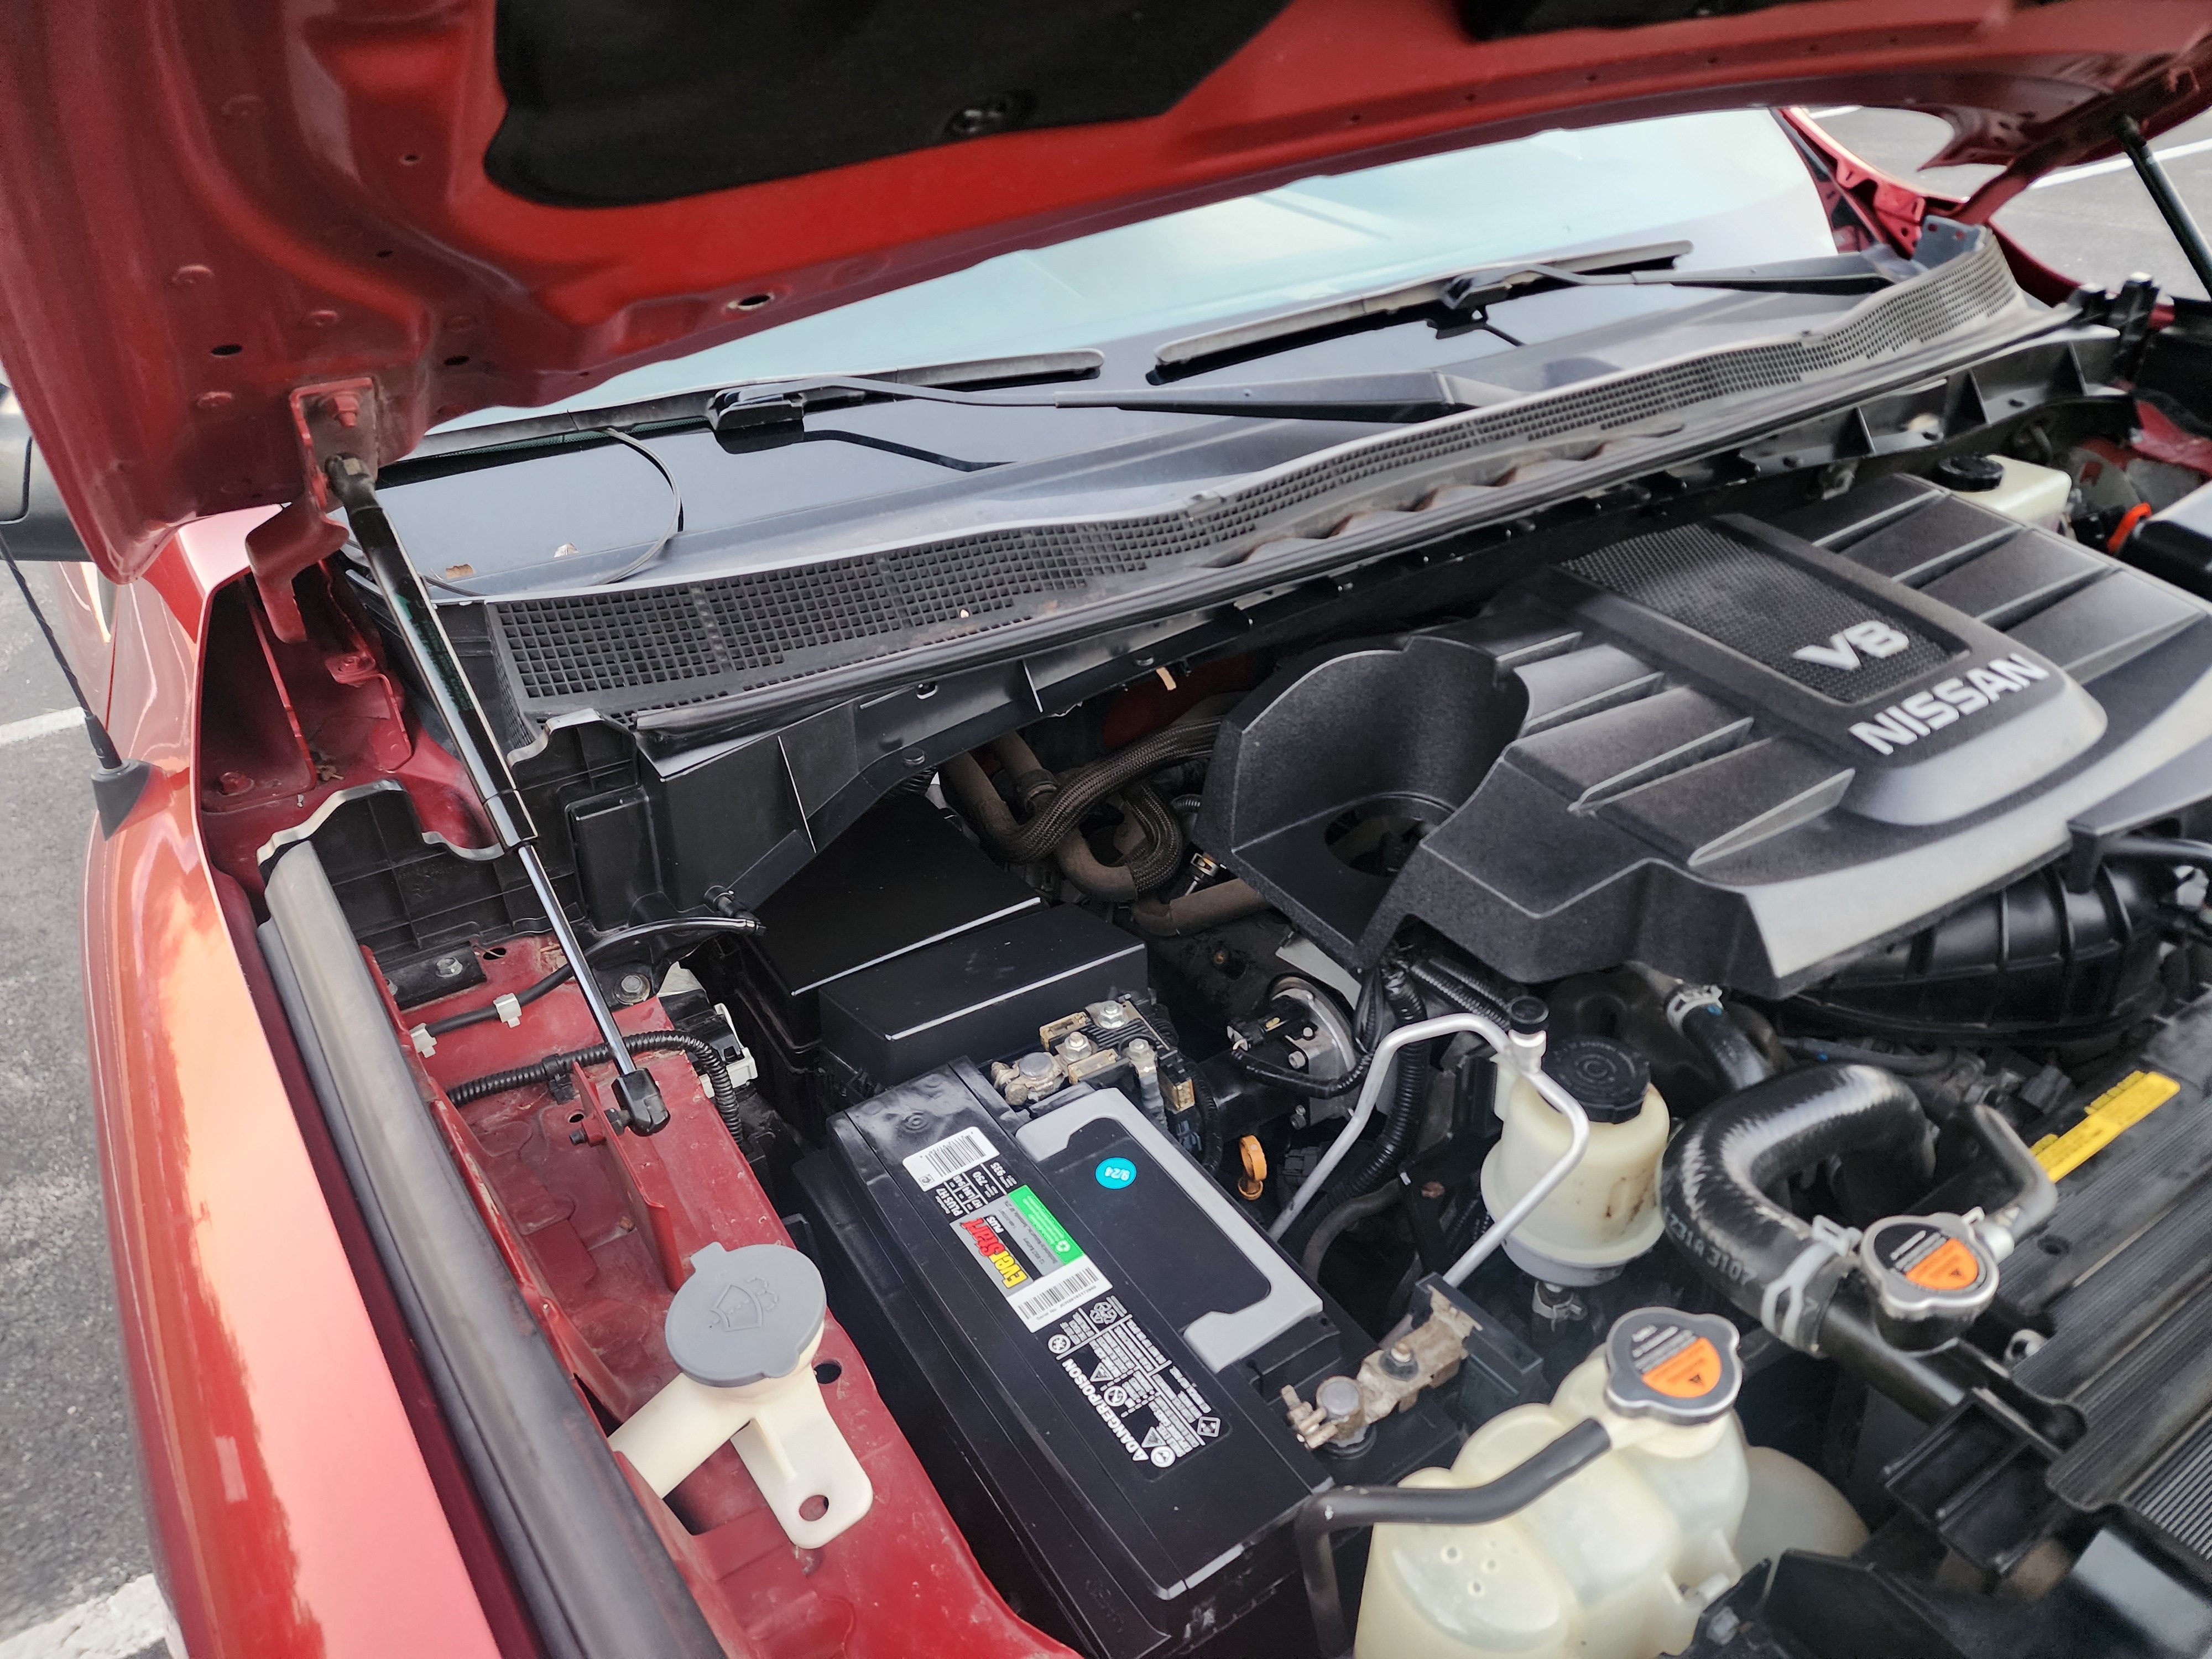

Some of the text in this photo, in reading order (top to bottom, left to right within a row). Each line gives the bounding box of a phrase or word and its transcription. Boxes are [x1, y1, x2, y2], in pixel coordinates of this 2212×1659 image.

[1792, 620, 1910, 671] V8
[1848, 653, 2050, 755] NISSAN
[971, 1170, 989, 1186] 750
[989, 1161, 1006, 1176] 935
[936, 1187, 950, 1198] H7
[985, 1215, 1005, 1233] PLUS
[959, 1216, 1029, 1289] EverStart
[1062, 1358, 1139, 1453] DANGER/POISON
